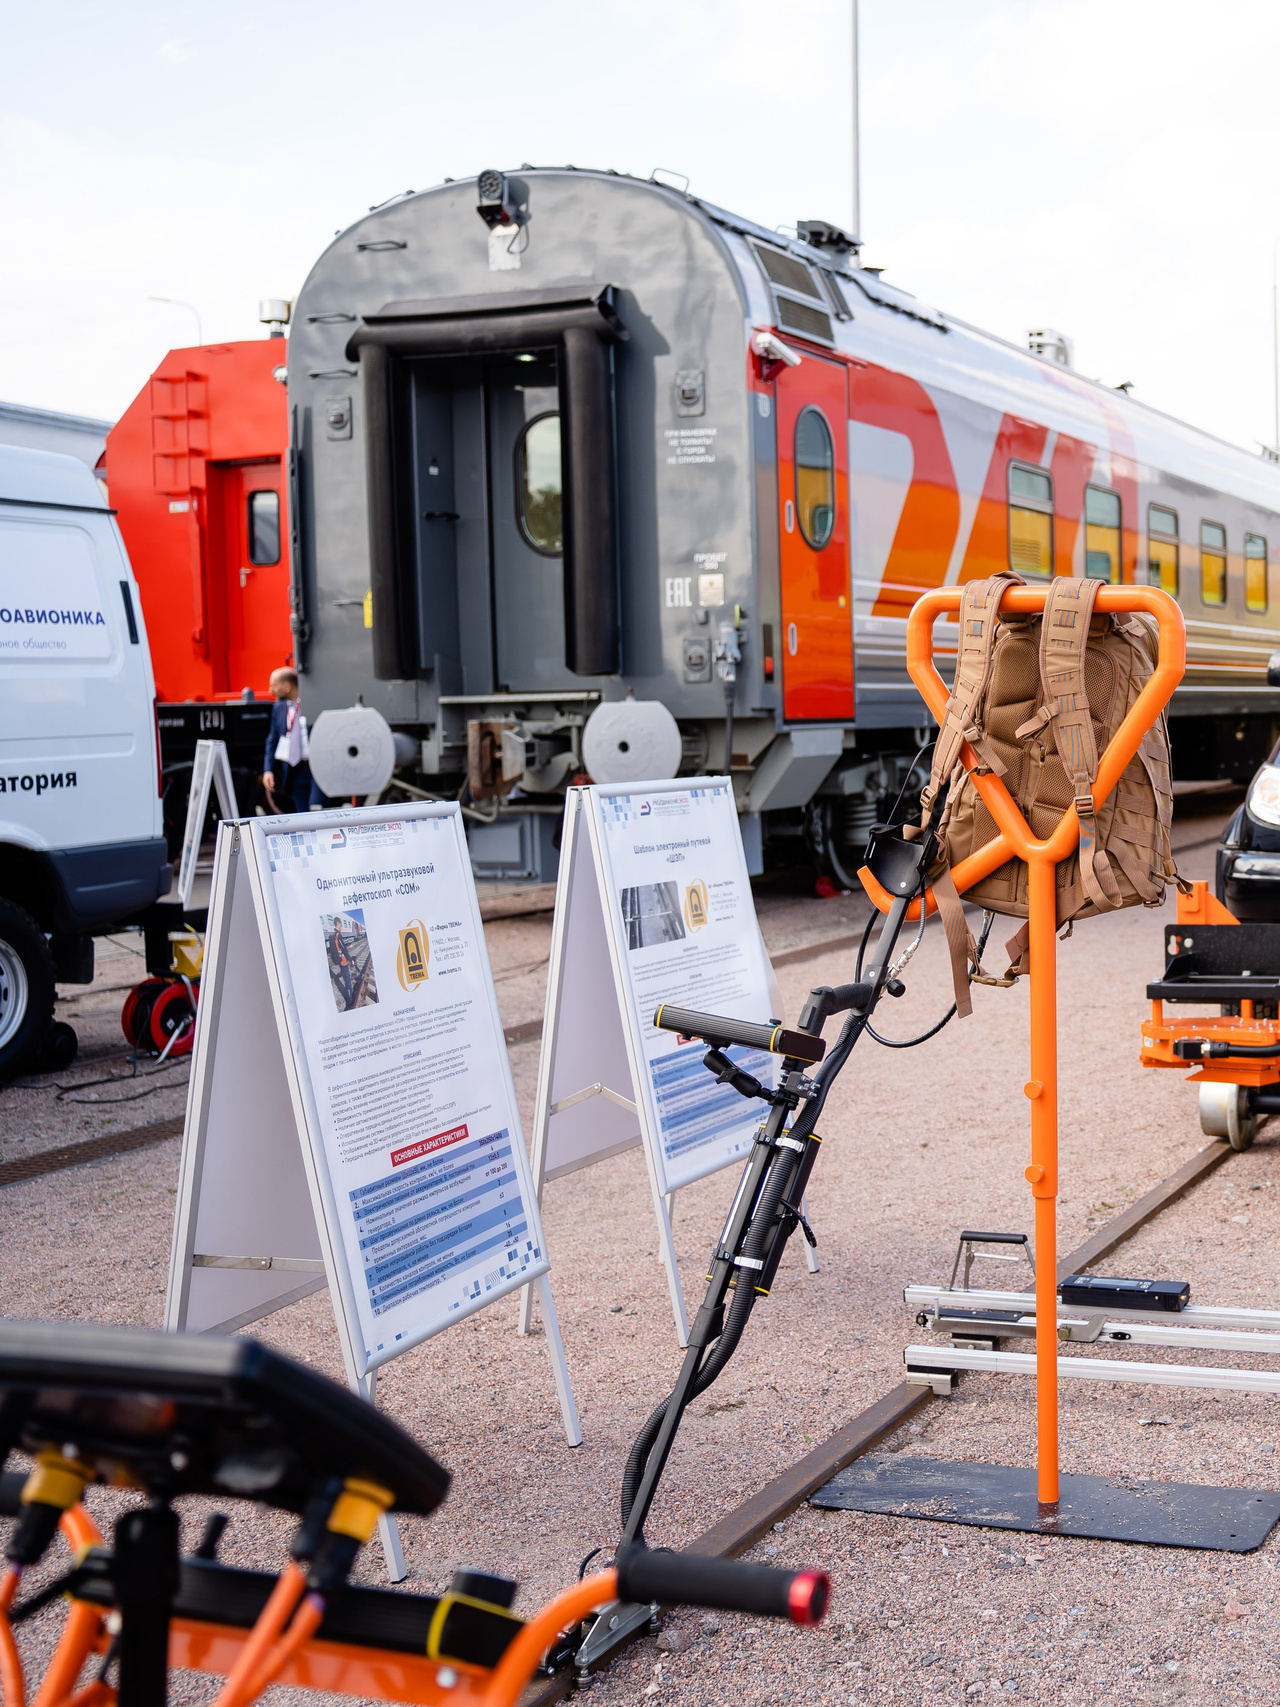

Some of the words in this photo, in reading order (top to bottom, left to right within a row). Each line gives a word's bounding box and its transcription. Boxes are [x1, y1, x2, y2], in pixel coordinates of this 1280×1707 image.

[0, 608, 106, 626] ОАВИОНИКА
[22, 636, 67, 650] общество
[633, 845, 654, 854] Шаблон
[655, 839, 689, 851] электронный
[690, 836, 710, 847] путевой
[315, 870, 376, 890] Однониточный
[377, 862, 434, 883] ультразвуковой
[342, 889, 392, 906] дефектоскоп
[395, 882, 420, 896] «СОМ»
[393, 1143, 422, 1163] ОСНОВНЫЕ
[422, 1126, 466, 1152] ХАРАКТЕРИСТИКИ
